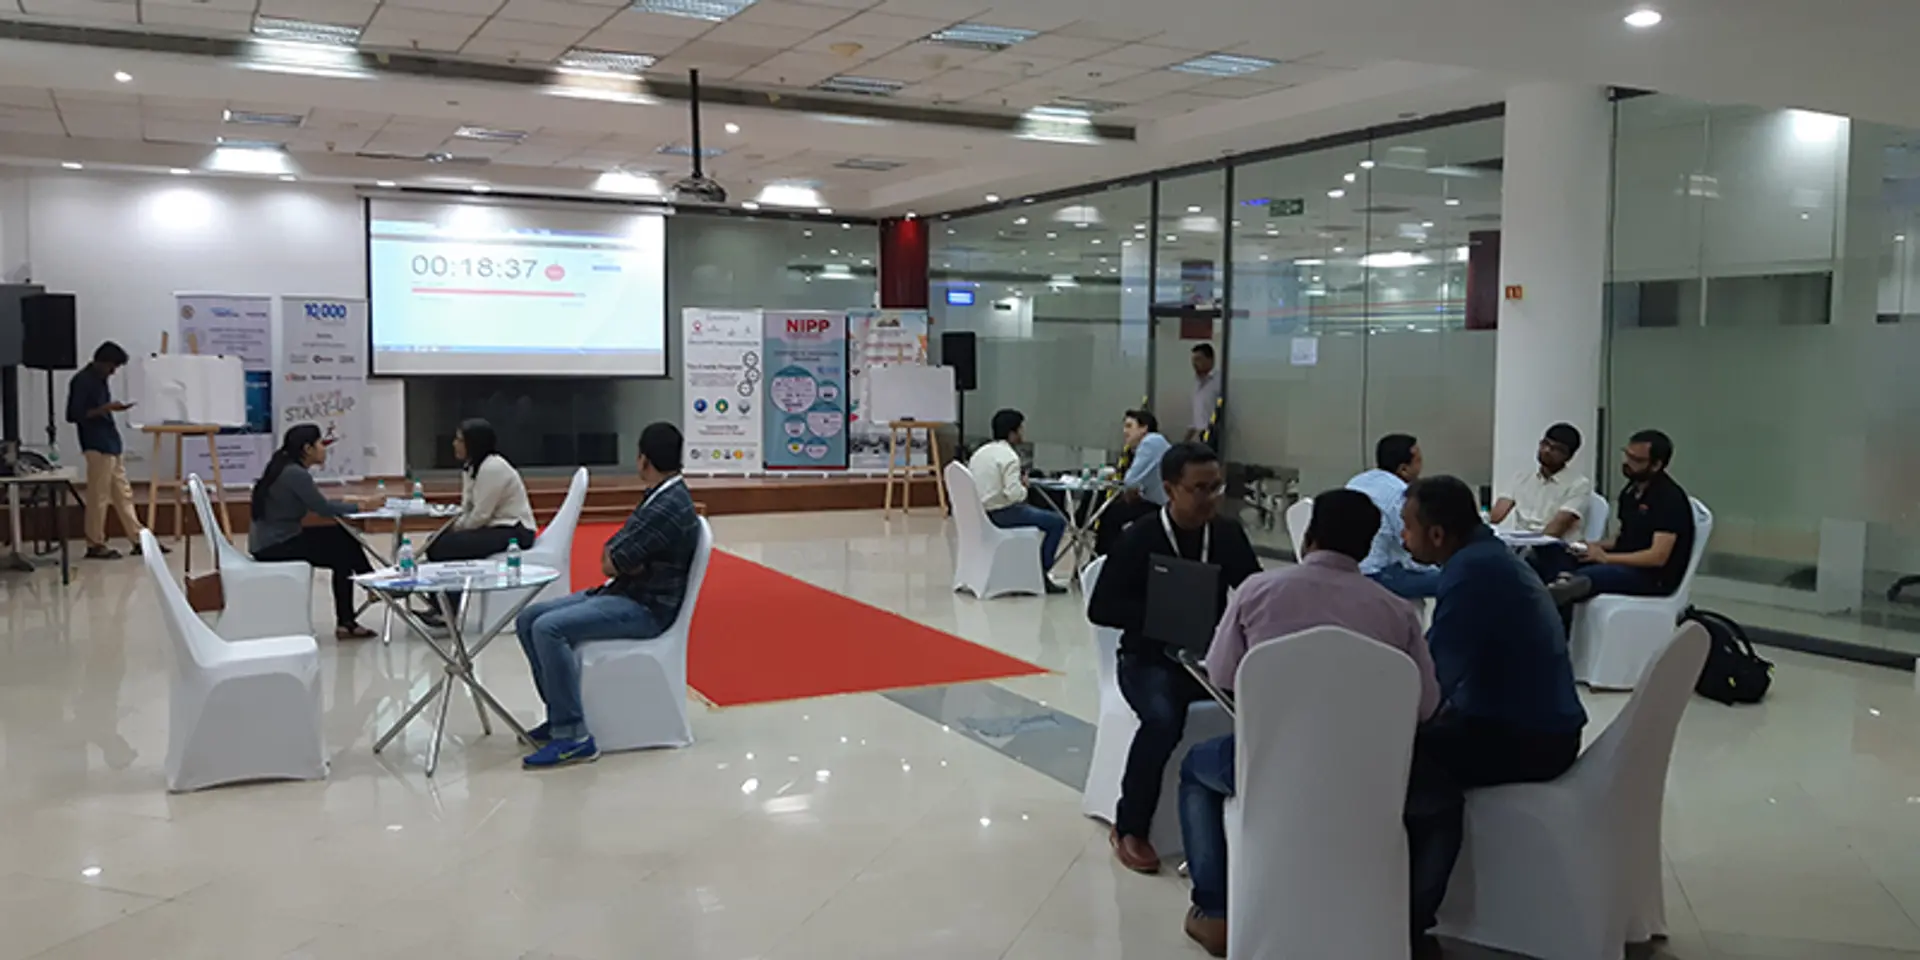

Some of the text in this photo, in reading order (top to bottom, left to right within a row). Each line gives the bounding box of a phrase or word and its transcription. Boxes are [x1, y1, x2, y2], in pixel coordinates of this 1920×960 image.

[411, 254, 538, 280] 00:18:37
[786, 319, 830, 333] NIPP
[285, 394, 356, 422] START-UP
